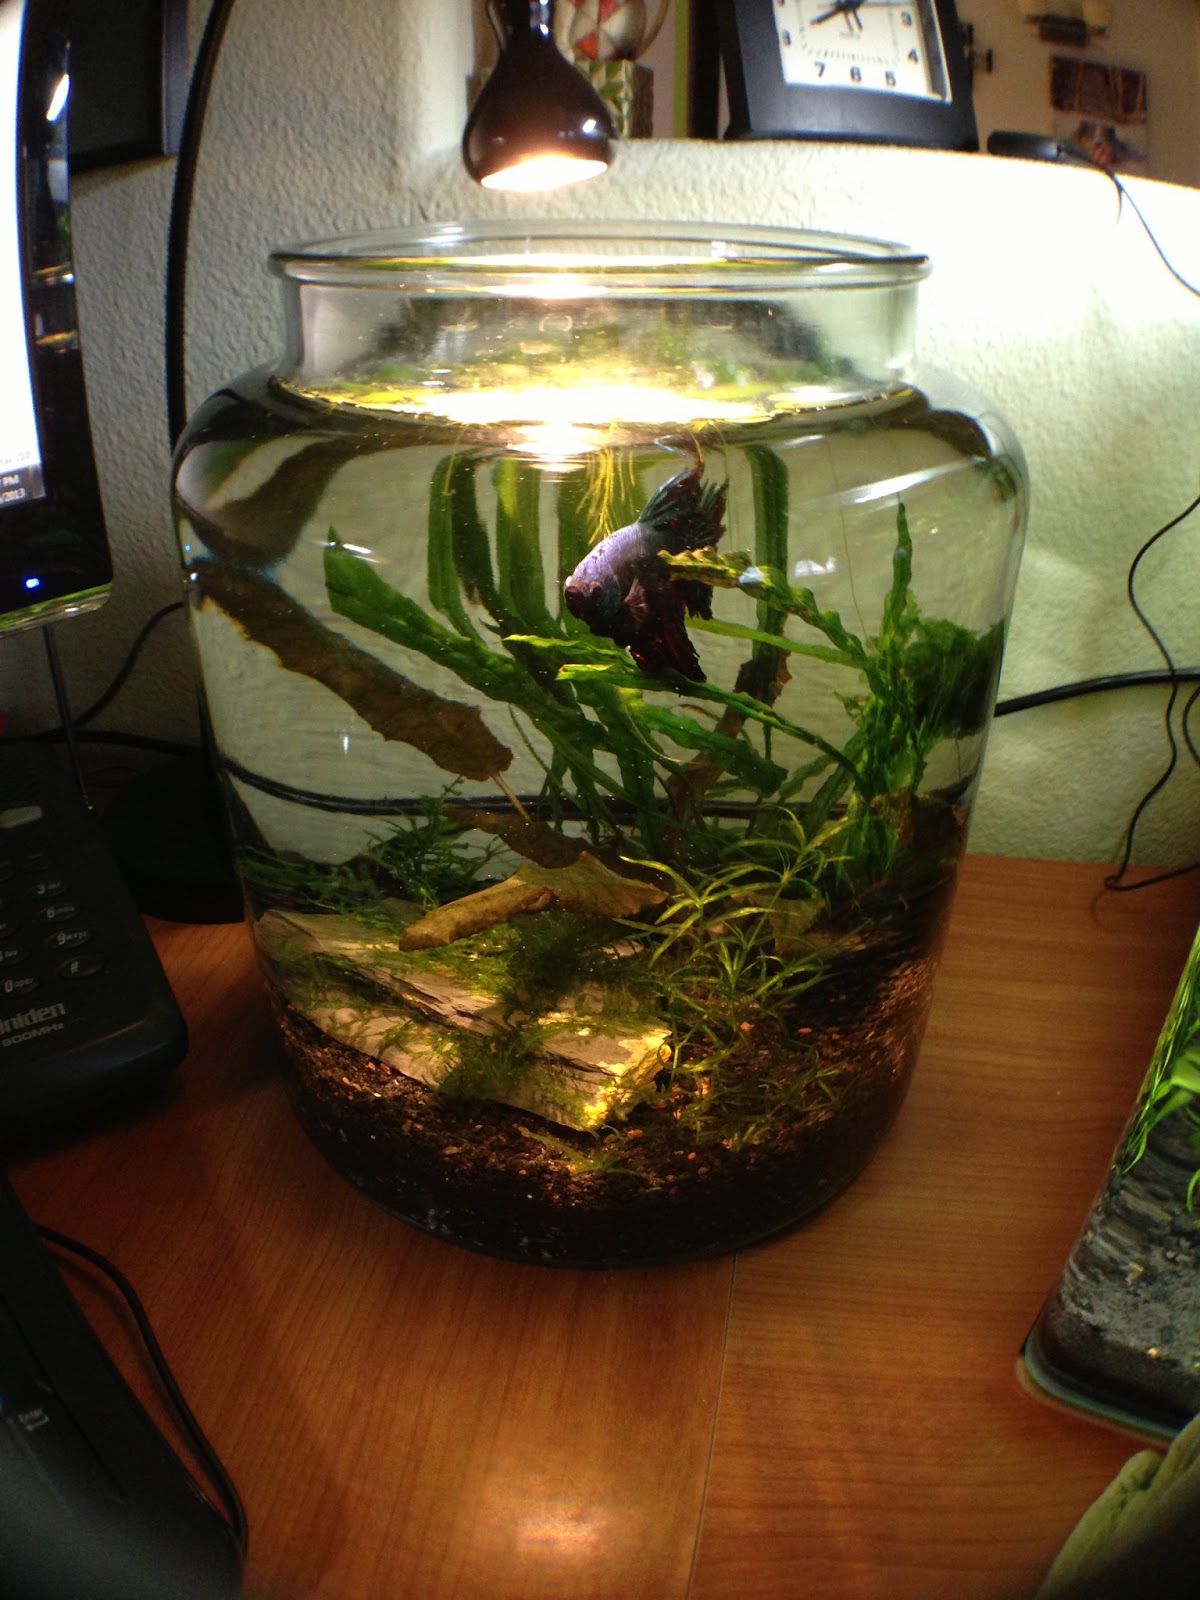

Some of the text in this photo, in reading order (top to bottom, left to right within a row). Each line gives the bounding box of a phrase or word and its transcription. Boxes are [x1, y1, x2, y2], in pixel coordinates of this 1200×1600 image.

[901, 10, 912, 27] 3
[782, 30, 791, 46] 8
[907, 49, 918, 64] 4
[815, 61, 826, 78] 7
[850, 66, 862, 82] 6
[885, 71, 896, 87] 5
[2, 474, 20, 487] PM
